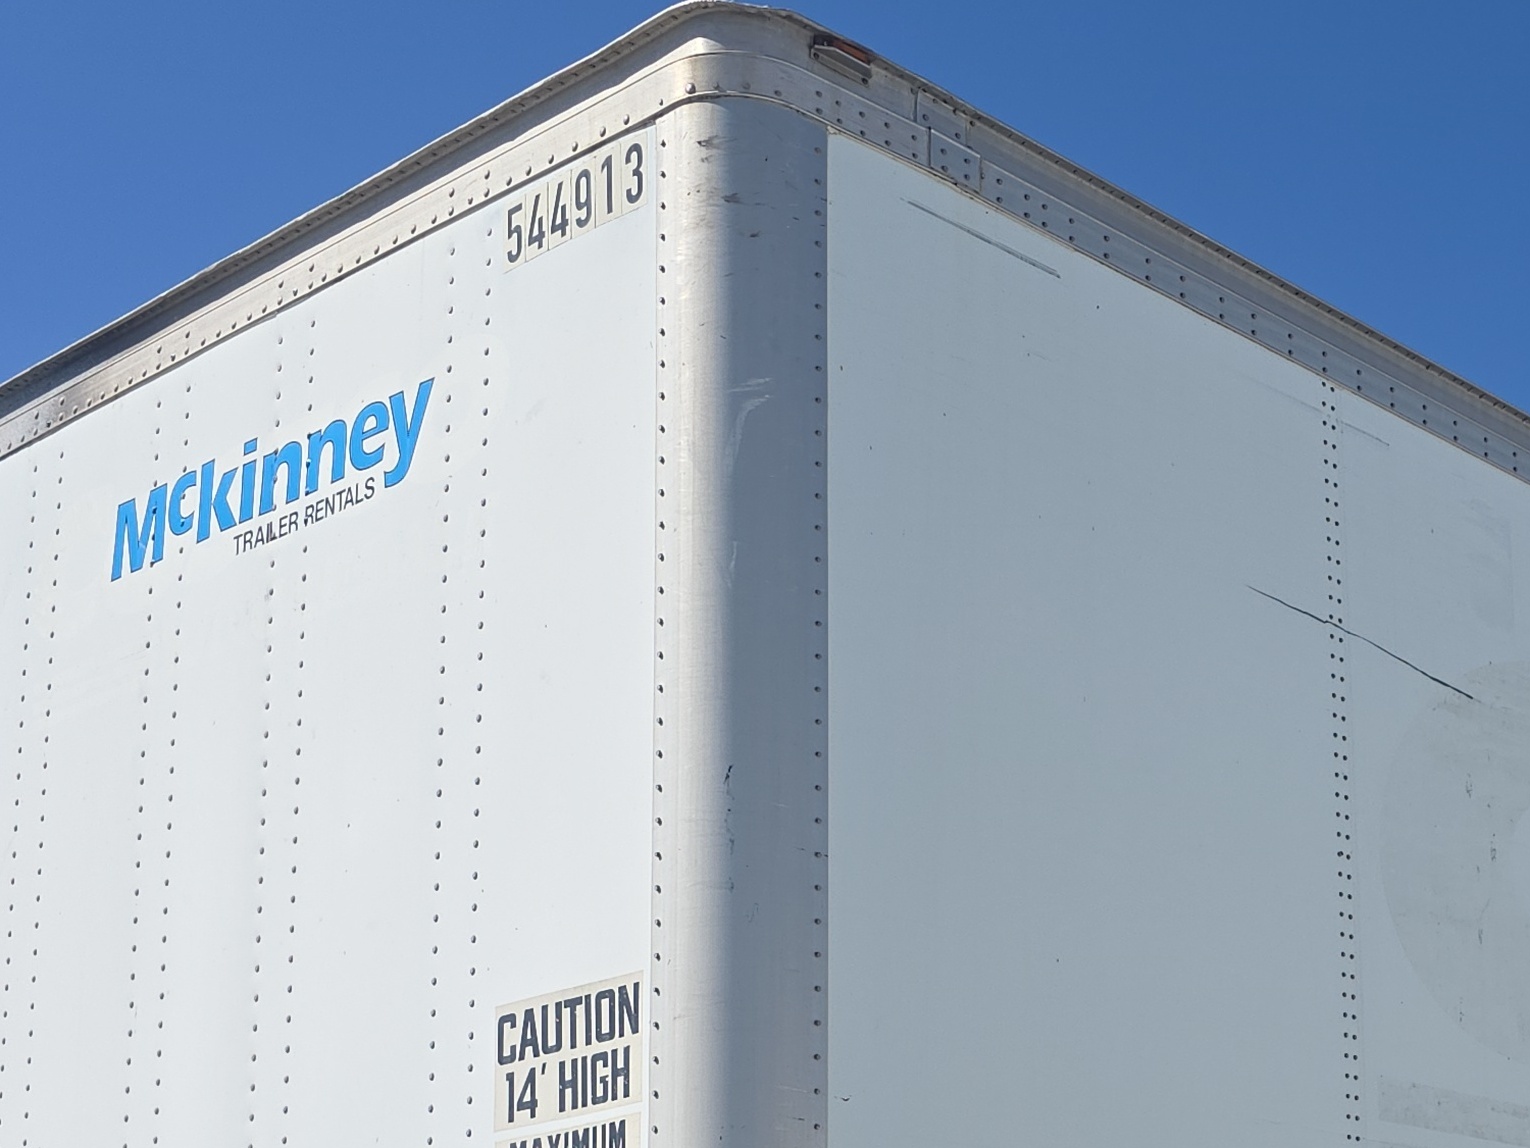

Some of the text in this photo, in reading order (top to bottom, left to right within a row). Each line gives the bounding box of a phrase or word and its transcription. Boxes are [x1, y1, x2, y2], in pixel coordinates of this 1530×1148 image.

[506, 142, 644, 266] 544913
[233, 476, 376, 556] TRAILER RENTALS
[496, 981, 641, 1066] CAUTION
[557, 1045, 631, 1113] HIGH
